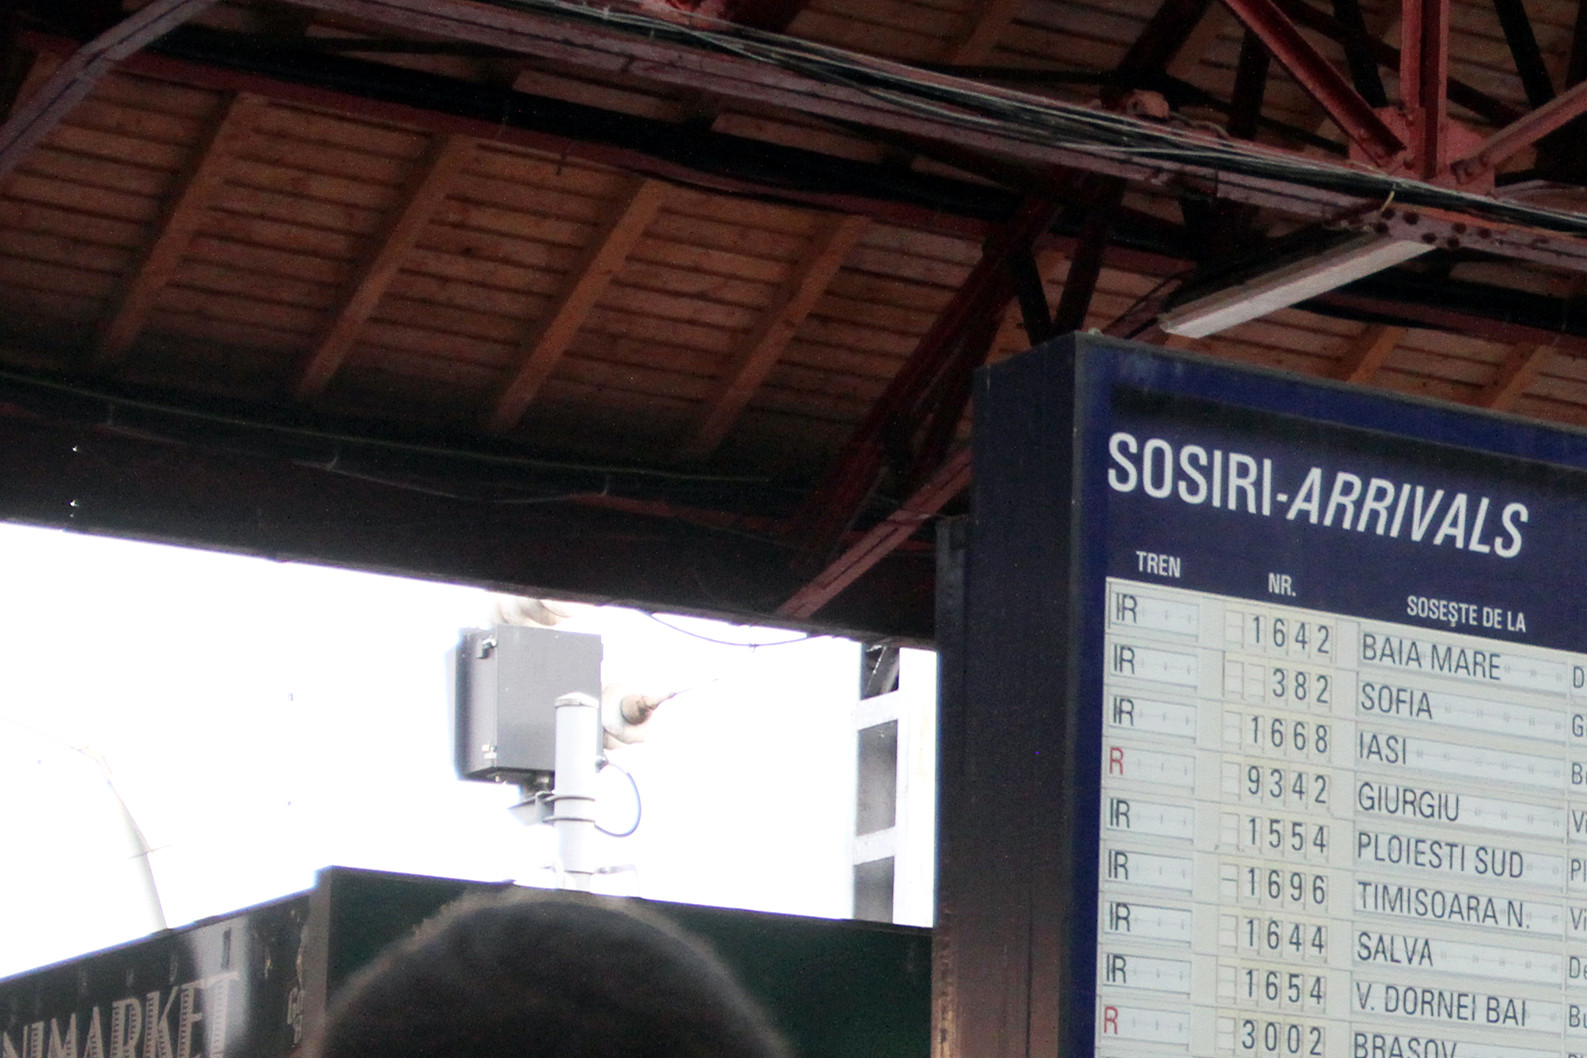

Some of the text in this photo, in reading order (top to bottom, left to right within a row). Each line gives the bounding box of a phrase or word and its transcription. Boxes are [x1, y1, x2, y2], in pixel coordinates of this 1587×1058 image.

[1107, 432, 1528, 559] SOSIRI-ARRIVALS
[1137, 551, 1180, 579] TREN
[1269, 572, 1296, 597] NR.
[1483, 607, 1502, 629] DE
[1507, 612, 1526, 632] LA
[1115, 593, 1138, 624] IR
[1253, 615, 1329, 655] 1642
[1363, 633, 1422, 668] BAIA
[1431, 645, 1501, 680] MARE
[1113, 644, 1135, 675] IR
[1272, 668, 1329, 703] 382
[1361, 683, 1433, 720] SOFIA
[1113, 697, 1134, 727] IR
[1251, 716, 1328, 753] 1668
[1358, 733, 1406, 765] IASI
[1109, 747, 1124, 775] R
[1248, 766, 1327, 803] 9342
[1358, 782, 1460, 821] GIURGIU
[1108, 798, 1130, 828] IR
[1248, 818, 1327, 853] 1554
[1358, 832, 1465, 872] PLOIESTI
[1475, 846, 1524, 879] SUD
[1108, 850, 1129, 880] IR
[1248, 868, 1325, 904] 1696
[1357, 881, 1498, 925] TIMISOARA
[1507, 901, 1530, 929] N.
[1109, 902, 1131, 932] IR
[1247, 918, 1325, 954] 1644
[1357, 932, 1433, 967] SALVA
[1106, 954, 1127, 983] IR
[1245, 969, 1323, 1004] 1654
[1356, 982, 1375, 1011] V.
[1385, 986, 1477, 1021] DORNEI
[1486, 998, 1527, 1026] BAI
[1104, 1006, 1118, 1035] R
[1242, 1020, 1322, 1056] 3002
